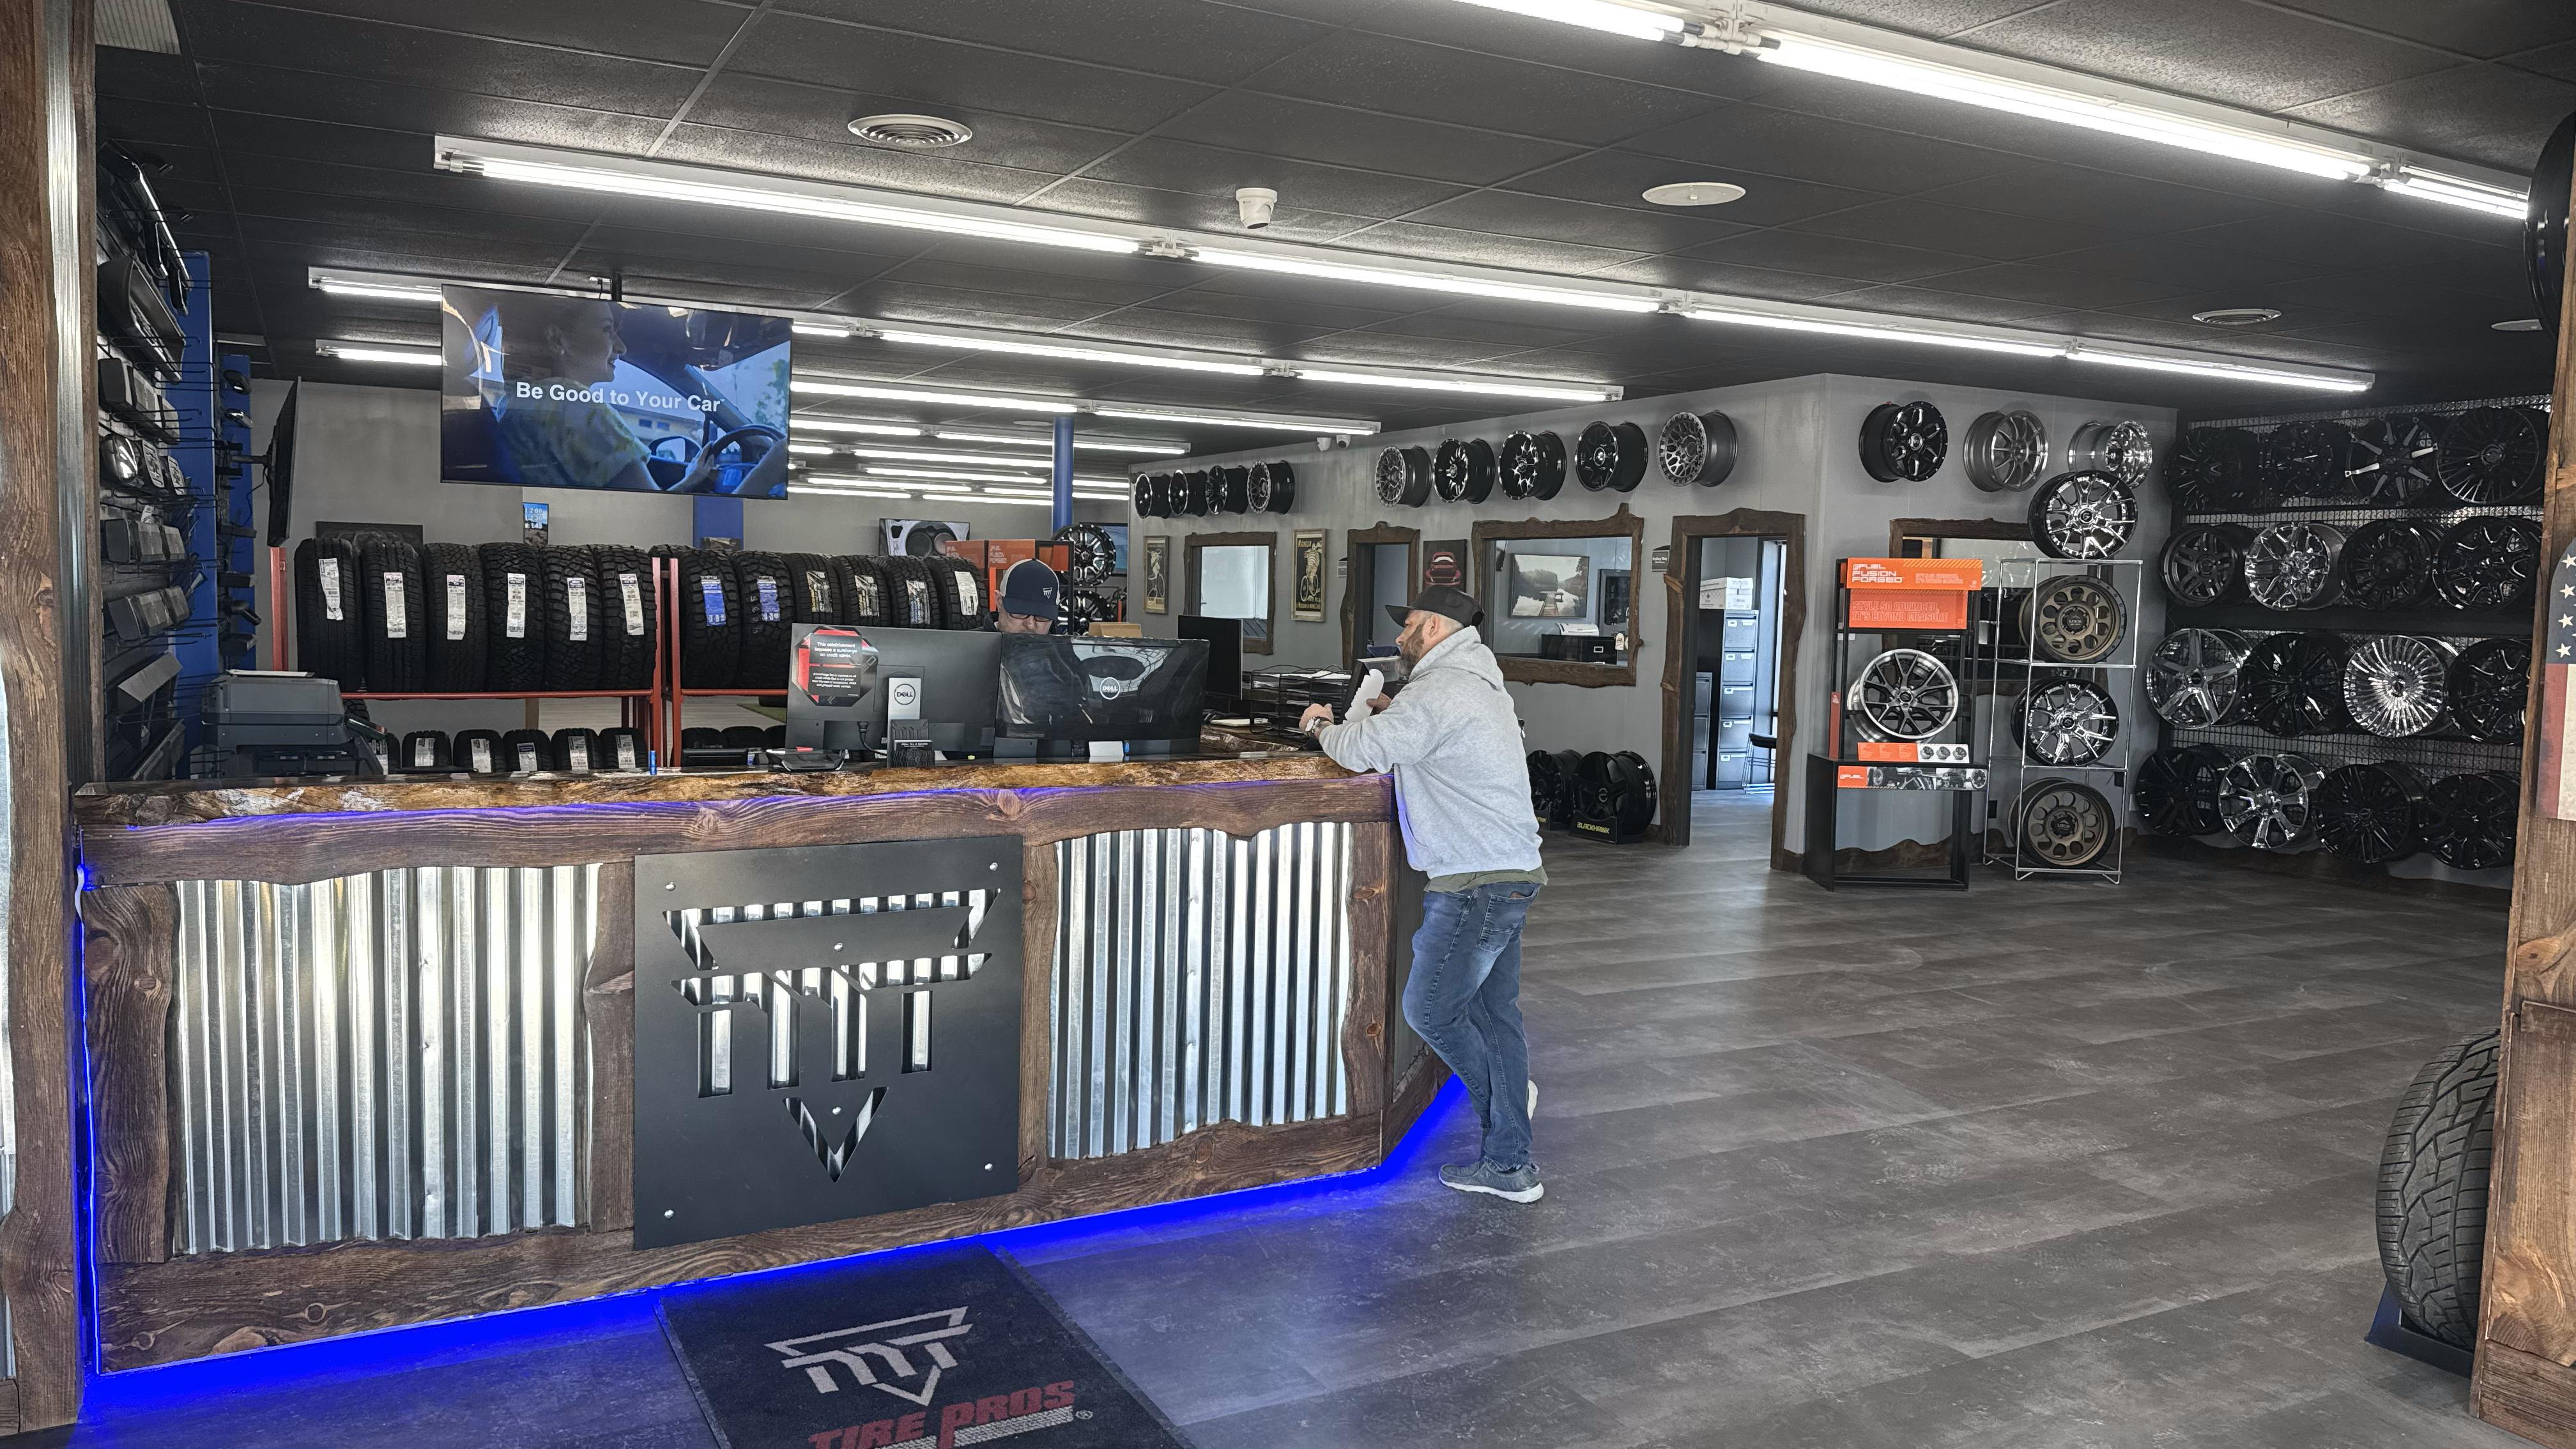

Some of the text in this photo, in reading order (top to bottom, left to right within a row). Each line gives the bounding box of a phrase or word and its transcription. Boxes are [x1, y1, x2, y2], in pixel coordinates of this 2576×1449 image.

[517, 382, 543, 399] Be
[549, 384, 604, 404] Good
[610, 390, 629, 405] to
[635, 391, 681, 409] Your
[1853, 601, 1879, 611] STYLE
[1880, 602, 1892, 611] SO
[1852, 611, 1948, 622] IT'S BEYOND MEASURE
[937, 1380, 1075, 1449] PROS
